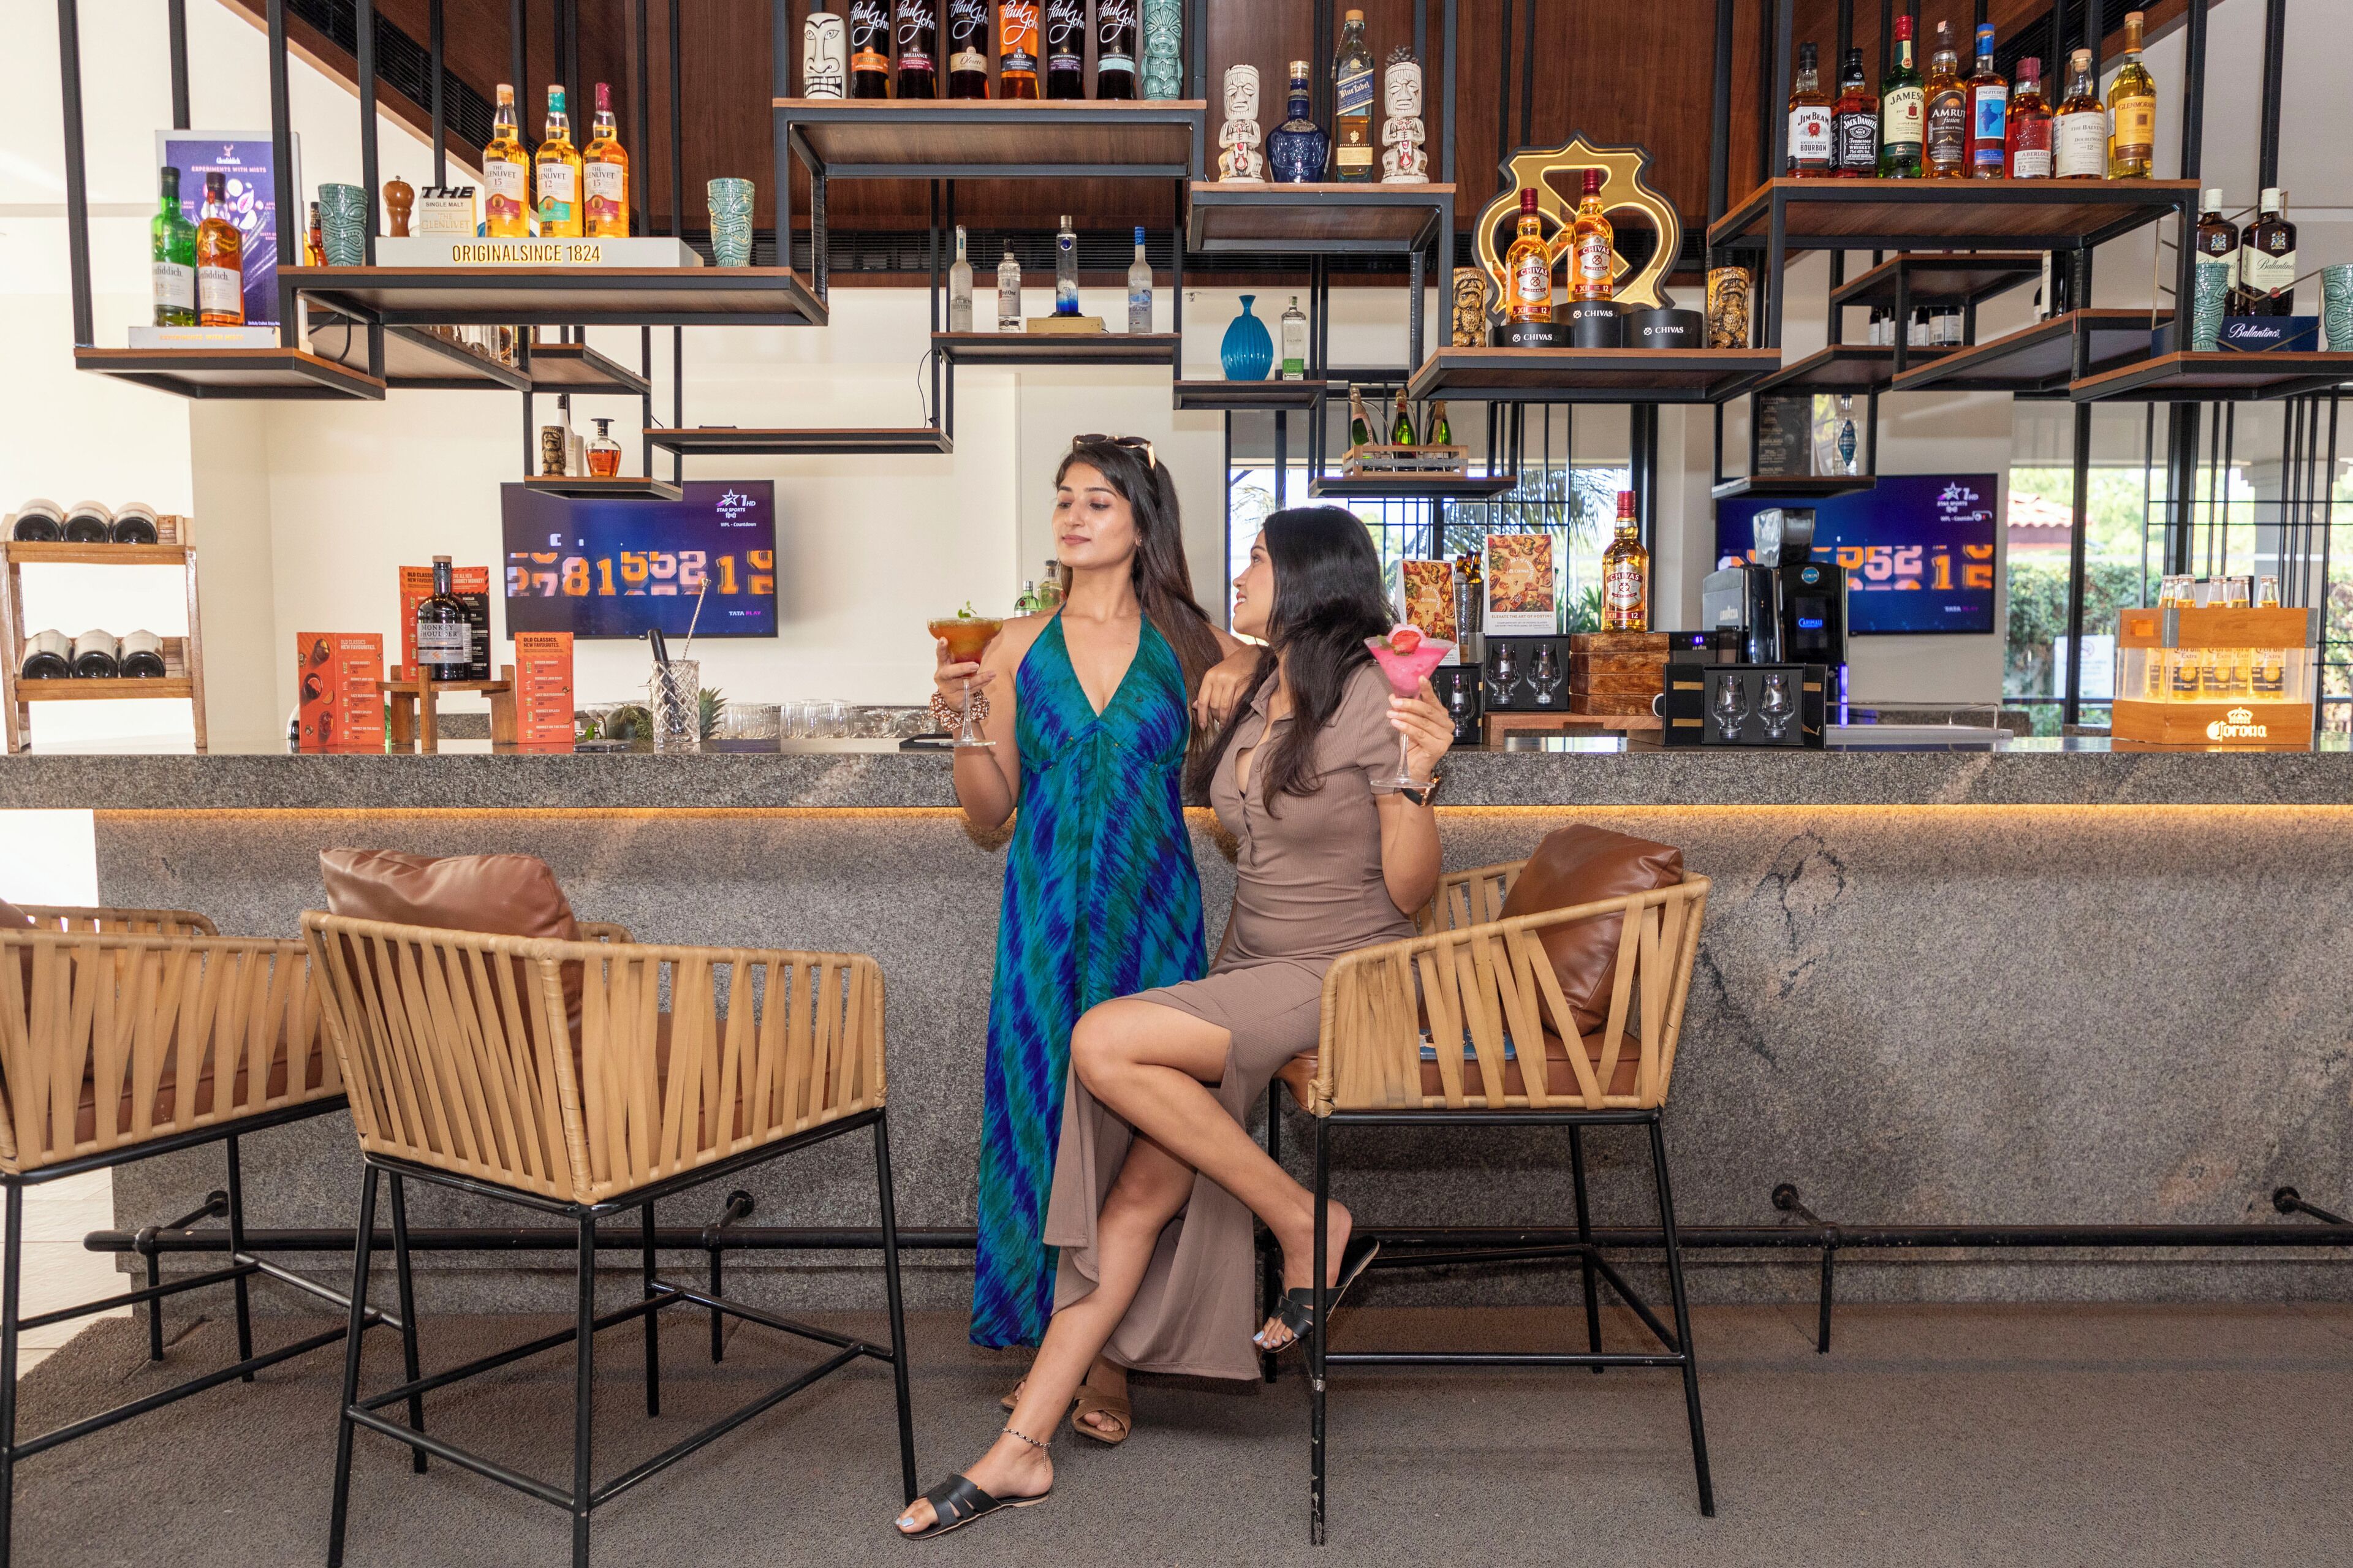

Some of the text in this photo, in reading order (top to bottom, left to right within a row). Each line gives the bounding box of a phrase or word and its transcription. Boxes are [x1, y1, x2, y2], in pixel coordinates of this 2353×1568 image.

[850, 1, 874, 25] Paul
[896, 0, 922, 22] Paul
[950, 0, 988, 39] Paul John
[1001, 0, 1029, 22] Paul
[1047, 0, 1074, 22] Paul
[1097, 0, 1136, 43] Paul John
[852, 10, 889, 46] John
[898, 9, 935, 44] John
[1049, 9, 1085, 44] John
[1339, 80, 1370, 99] Blue Label
[1798, 112, 1829, 126] JIM BEAM
[1844, 118, 1857, 129] JACK
[1941, 116, 1960, 125] fusion
[422, 186, 476, 199] THE
[422, 220, 470, 230] GLENLIVET
[566, 244, 601, 262] 1824
[1583, 245, 1610, 255] CHIVAS
[1520, 267, 1548, 276] CHIVAS
[2228, 323, 2281, 339] Ballantine's
[1525, 559, 1535, 580] HOSTING
[2206, 720, 2268, 742] Corona
